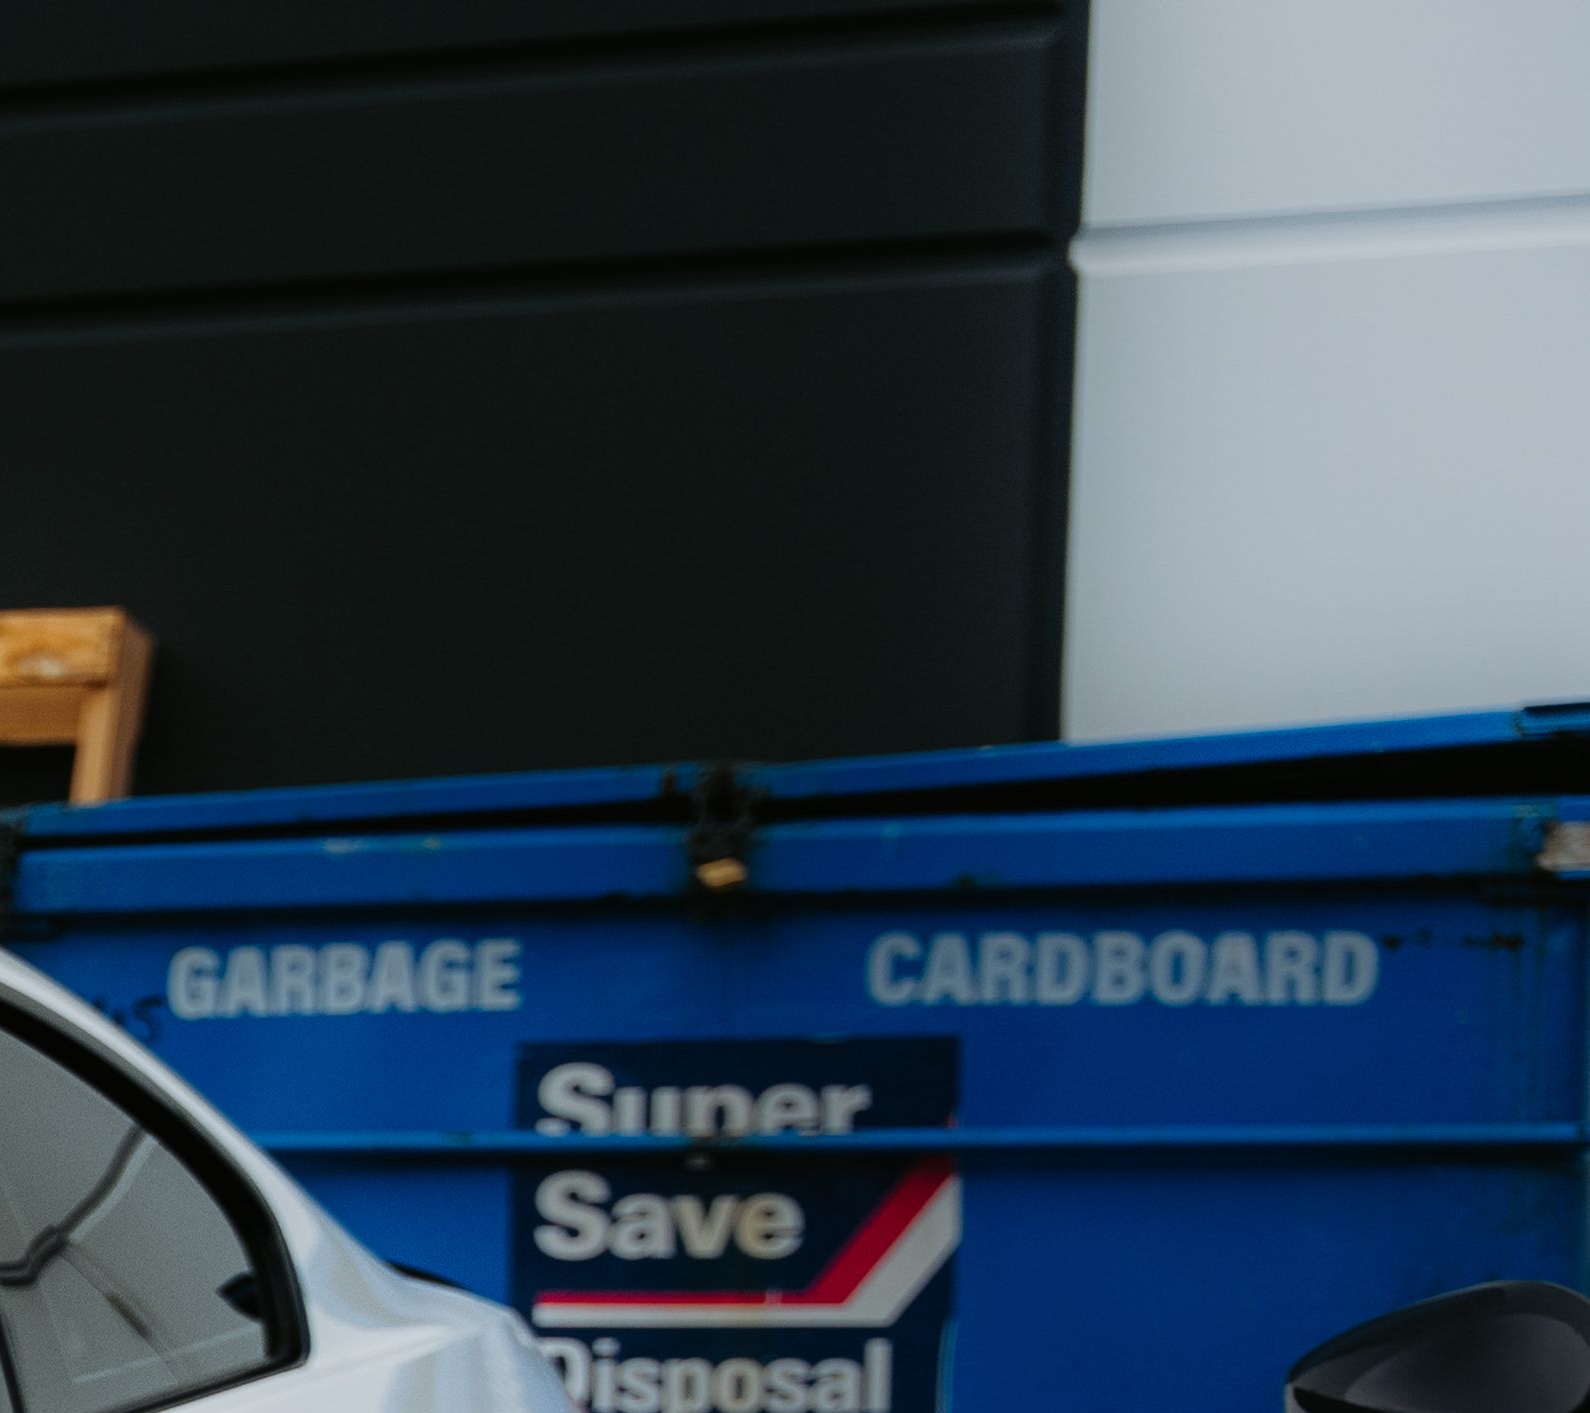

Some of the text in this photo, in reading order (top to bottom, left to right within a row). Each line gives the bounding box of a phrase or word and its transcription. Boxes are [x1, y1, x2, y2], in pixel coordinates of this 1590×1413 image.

[167, 939, 523, 1021] GARBAGE
[866, 930, 1380, 1008] CARDBOARD
[535, 1061, 873, 1138] Super
[532, 1168, 806, 1262] Save
